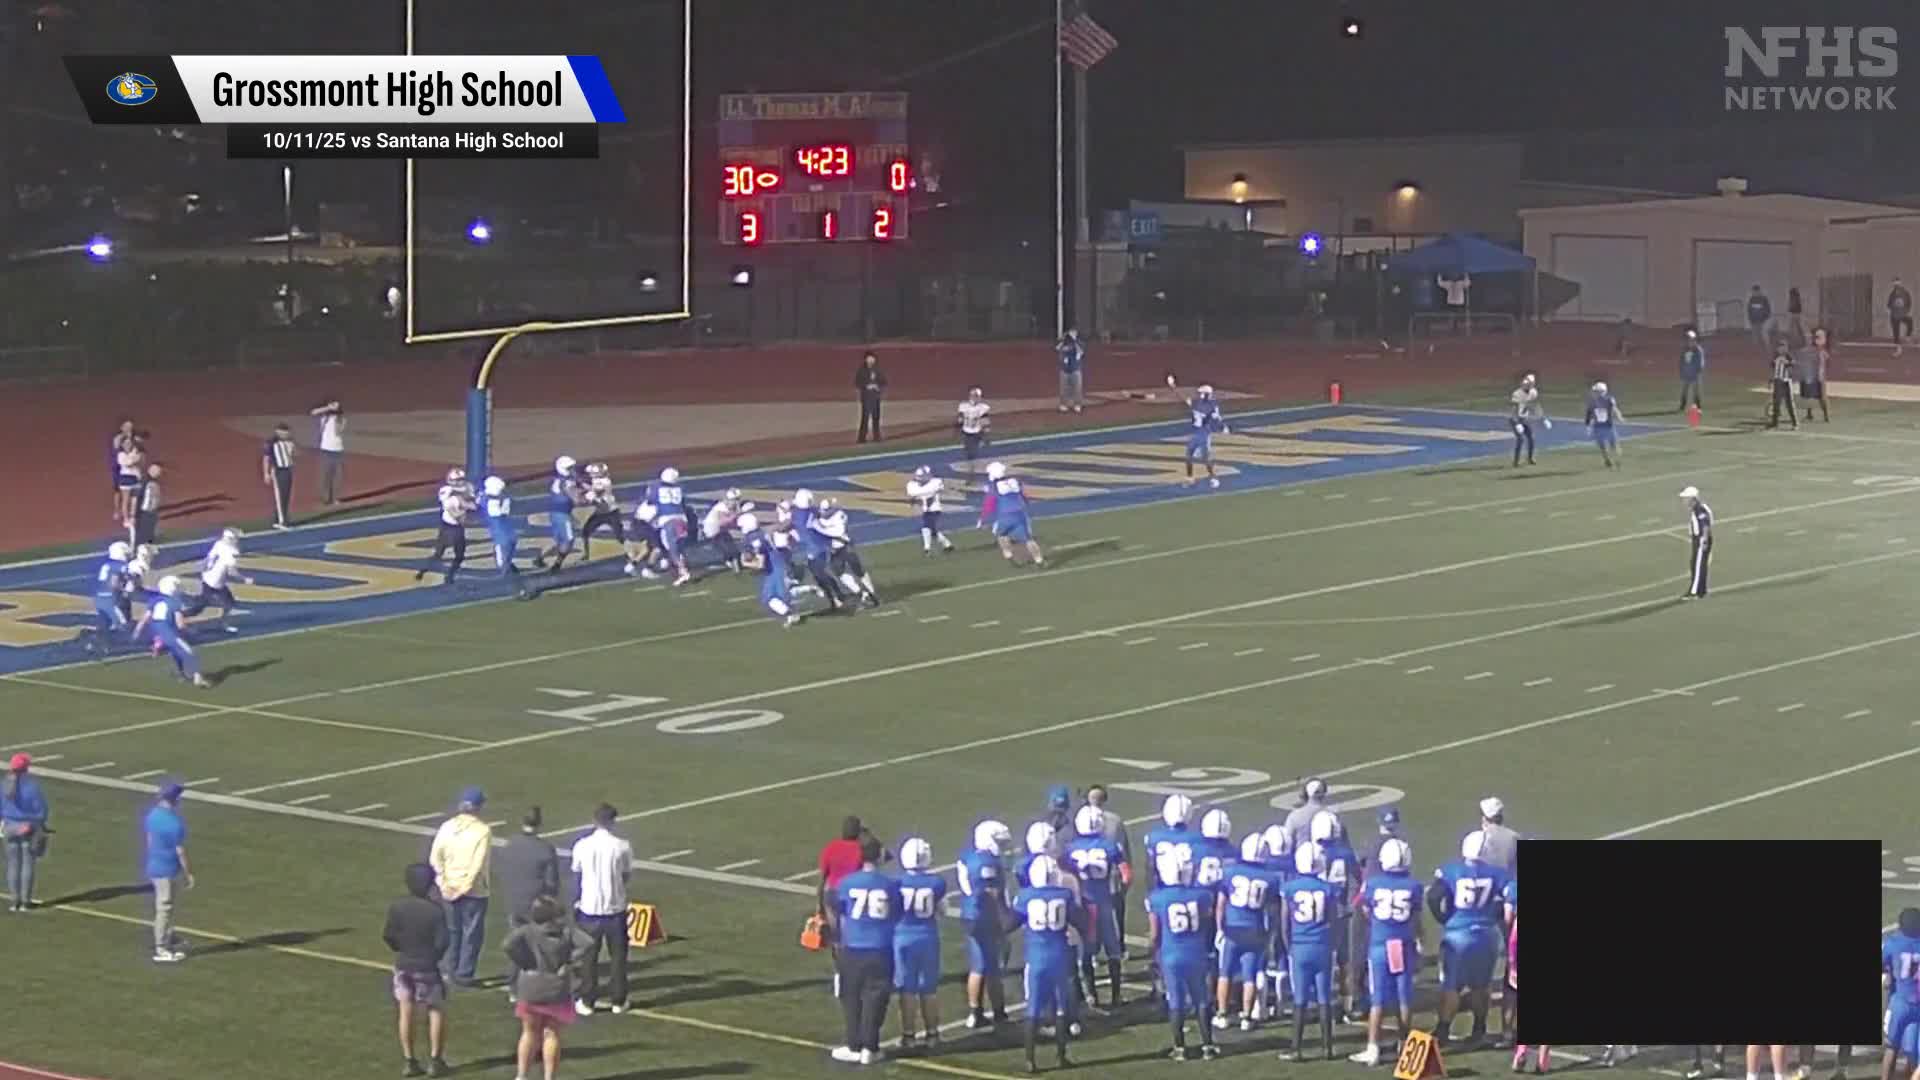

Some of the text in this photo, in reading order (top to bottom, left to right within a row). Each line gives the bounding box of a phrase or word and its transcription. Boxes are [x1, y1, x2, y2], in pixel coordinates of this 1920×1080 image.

[798, 147, 848, 174] 4:23
[725, 166, 754, 195] 30
[890, 162, 906, 191] 0
[742, 213, 757, 242] 3
[824, 212, 832, 238] 1
[873, 209, 889, 238] 2
[849, 887, 889, 920] 76
[1230, 874, 1269, 910] 30
[1293, 889, 1325, 923] 31
[1455, 877, 1493, 910] 67
[1168, 901, 1199, 934] 61
[1400, 1037, 1426, 1076] 30
